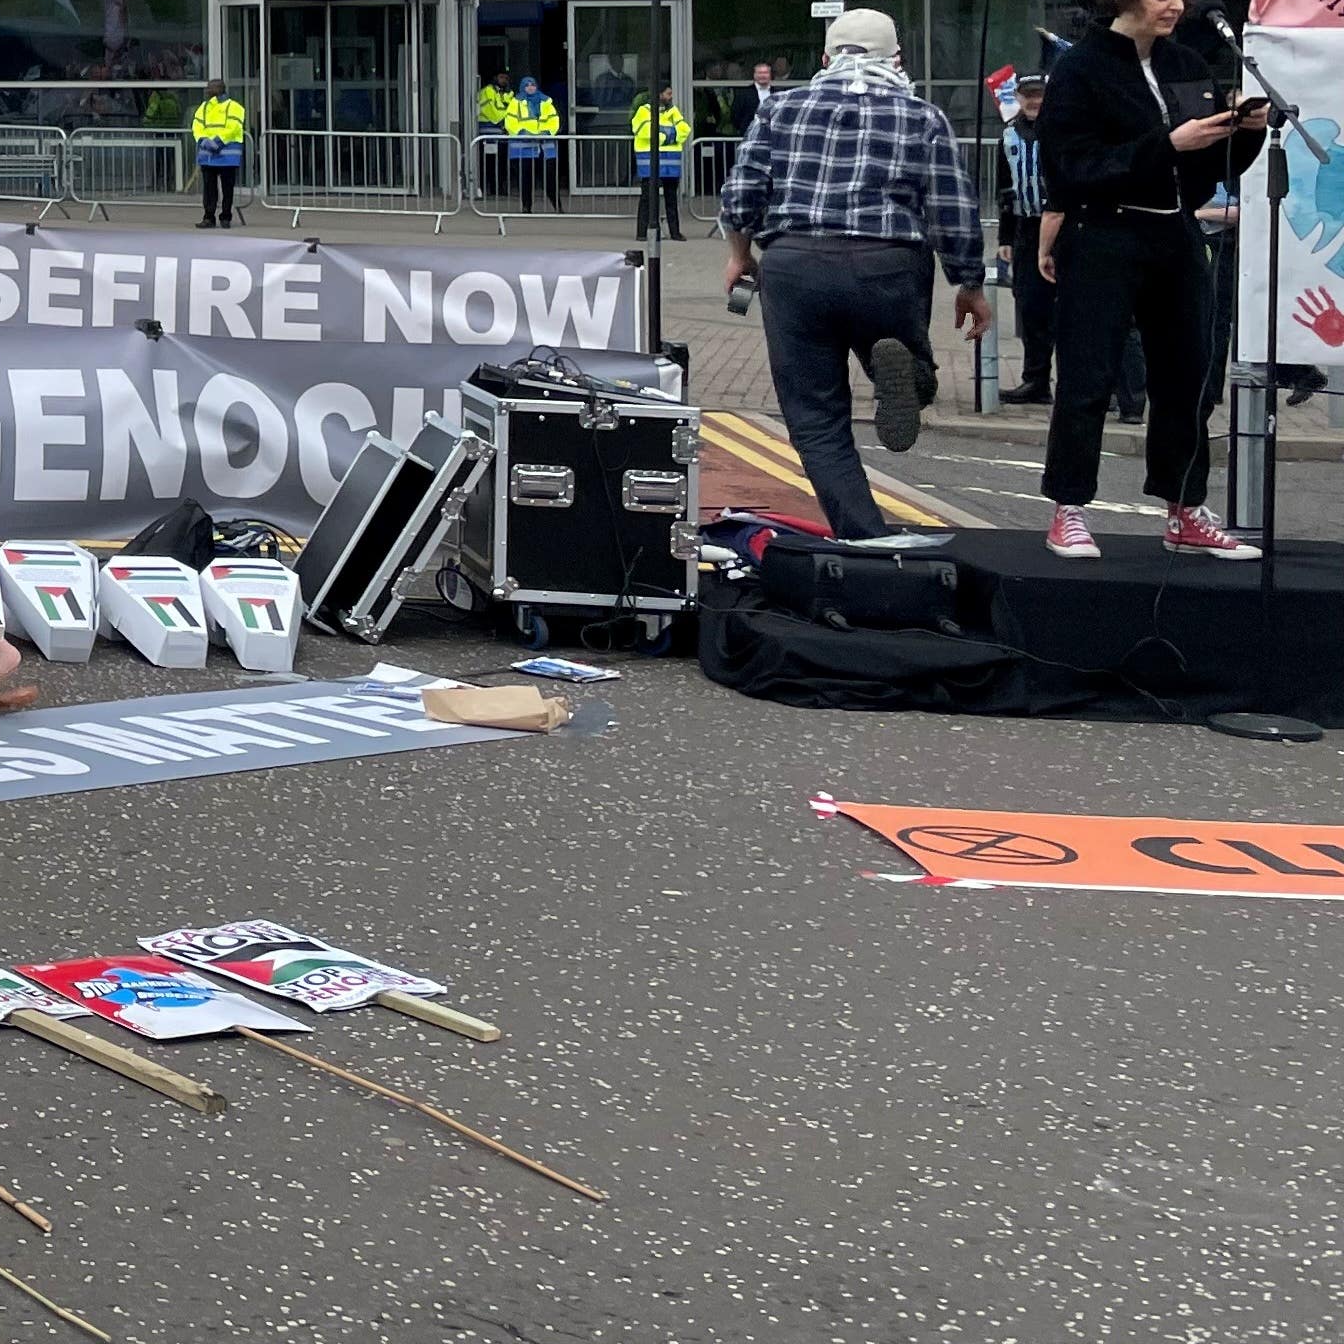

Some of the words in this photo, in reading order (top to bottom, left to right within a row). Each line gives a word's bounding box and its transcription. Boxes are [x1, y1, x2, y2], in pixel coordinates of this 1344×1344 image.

[364, 267, 621, 350] NOW
[19, 692, 463, 765] MATTE
[74, 981, 121, 999] STOP
[275, 968, 341, 995] STOP
